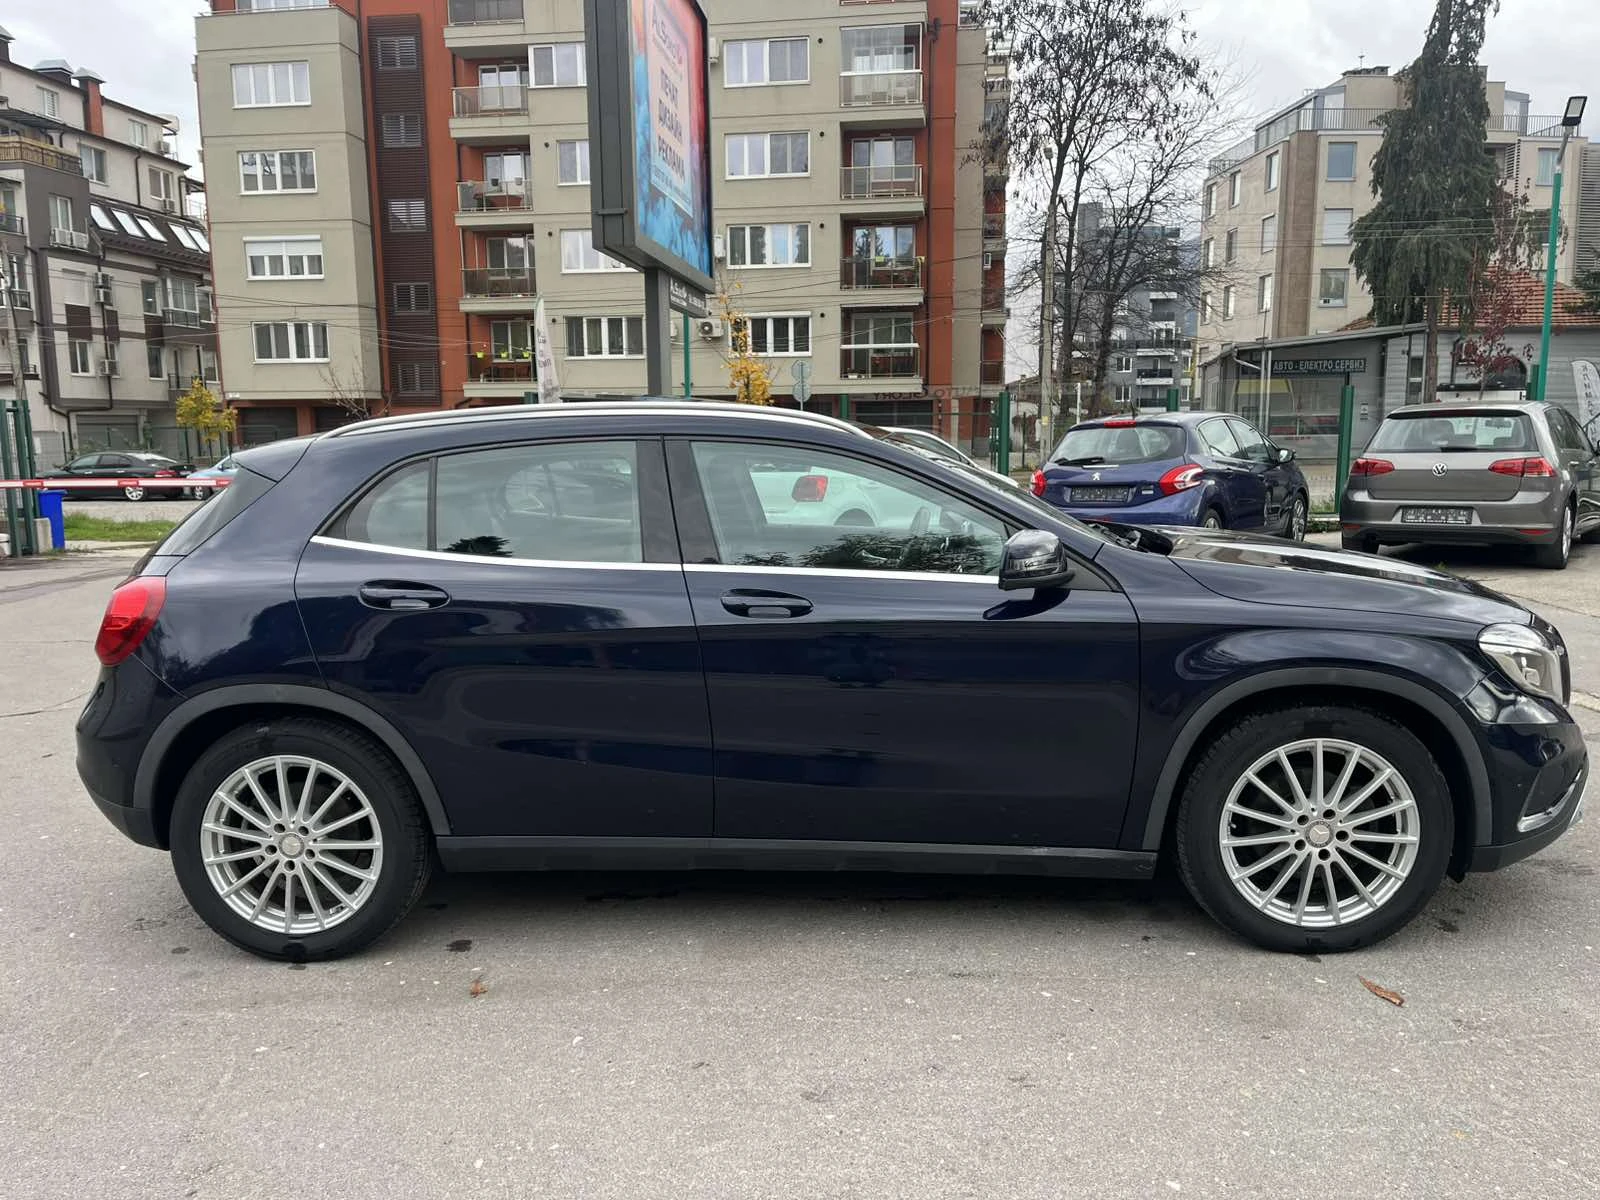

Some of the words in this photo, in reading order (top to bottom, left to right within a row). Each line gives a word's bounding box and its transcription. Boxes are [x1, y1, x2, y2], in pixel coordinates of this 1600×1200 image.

[1273, 360, 1294, 370] АВТО
[1300, 359, 1333, 370] ЕЛЕКТРО
[1335, 359, 1365, 369] СЕРВИЗ
